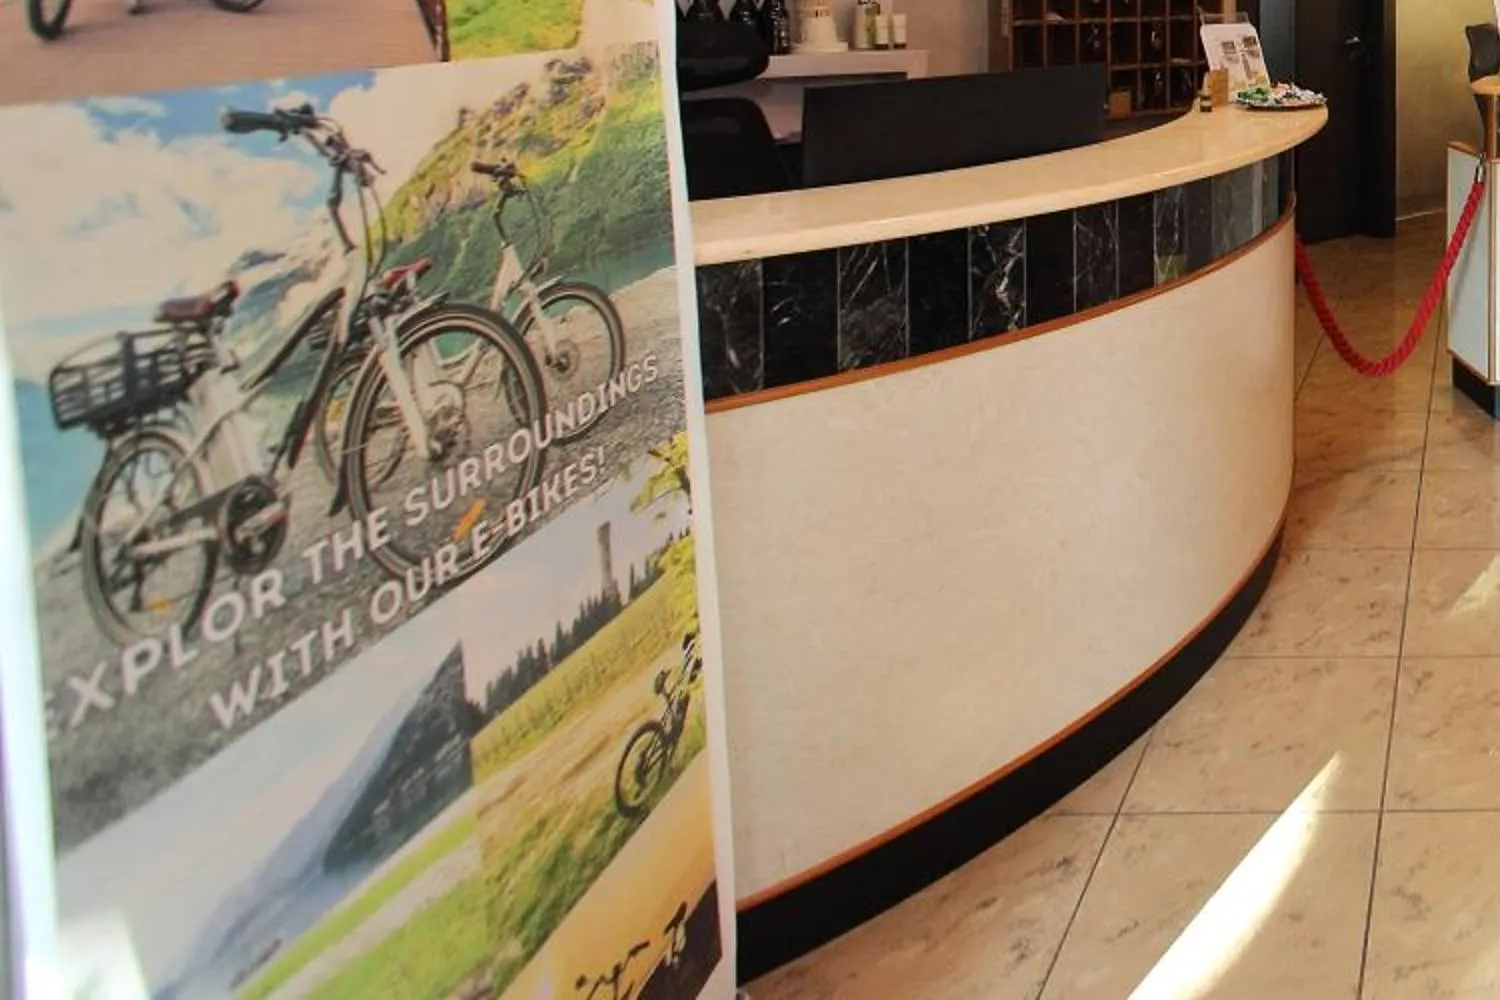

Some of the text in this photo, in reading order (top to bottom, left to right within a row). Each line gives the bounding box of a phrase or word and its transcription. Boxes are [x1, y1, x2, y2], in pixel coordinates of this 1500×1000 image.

[303, 506, 391, 584] THE
[405, 355, 659, 527] SURROUNDINGS
[209, 608, 354, 730] WITH
[369, 543, 459, 625] OUR
